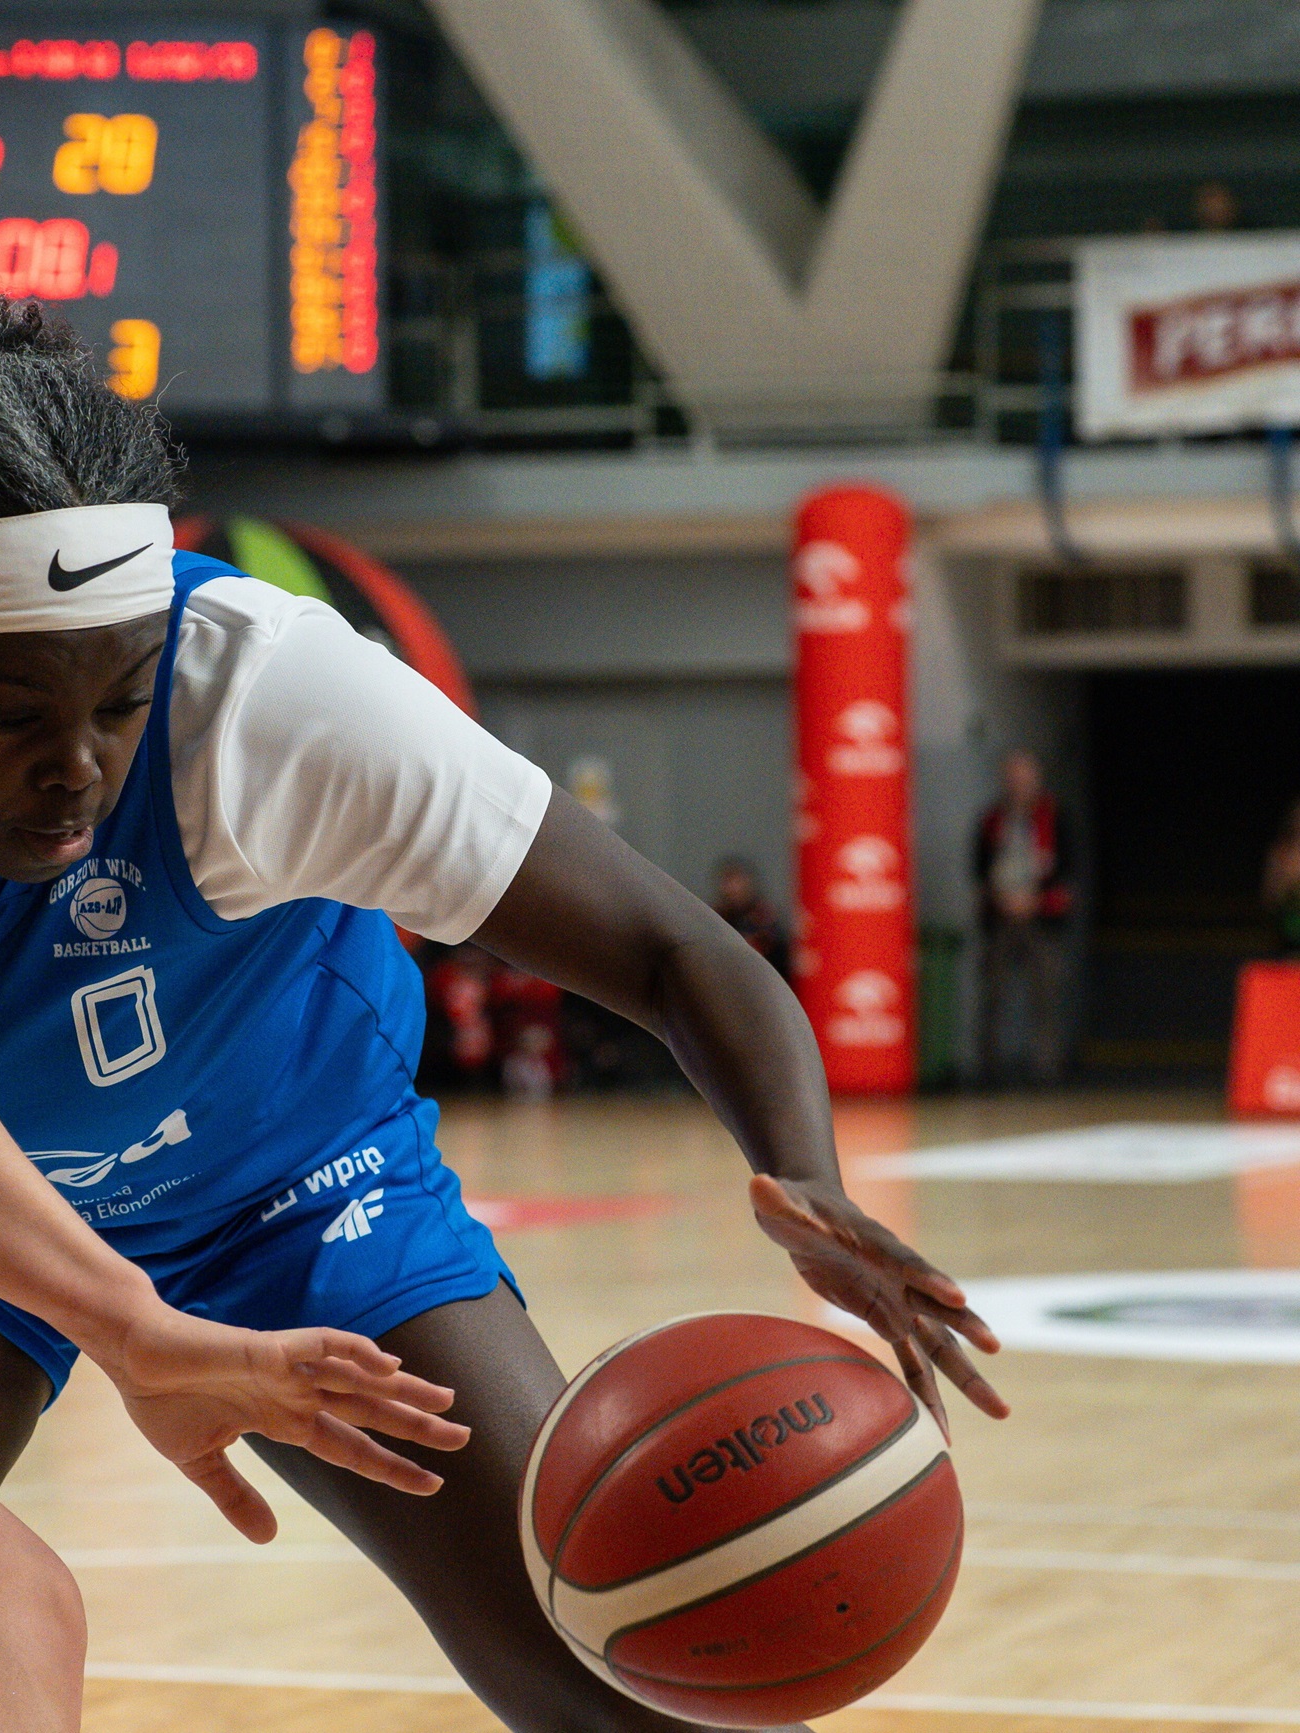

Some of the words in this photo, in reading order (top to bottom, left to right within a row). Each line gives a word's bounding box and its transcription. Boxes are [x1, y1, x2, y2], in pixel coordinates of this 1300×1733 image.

[106, 318, 162, 400] 3
[53, 936, 152, 957] BASKETBALL
[303, 1146, 386, 1195] wpip
[96, 1172, 202, 1220] Ekonomic
[655, 1392, 834, 1504] molten
